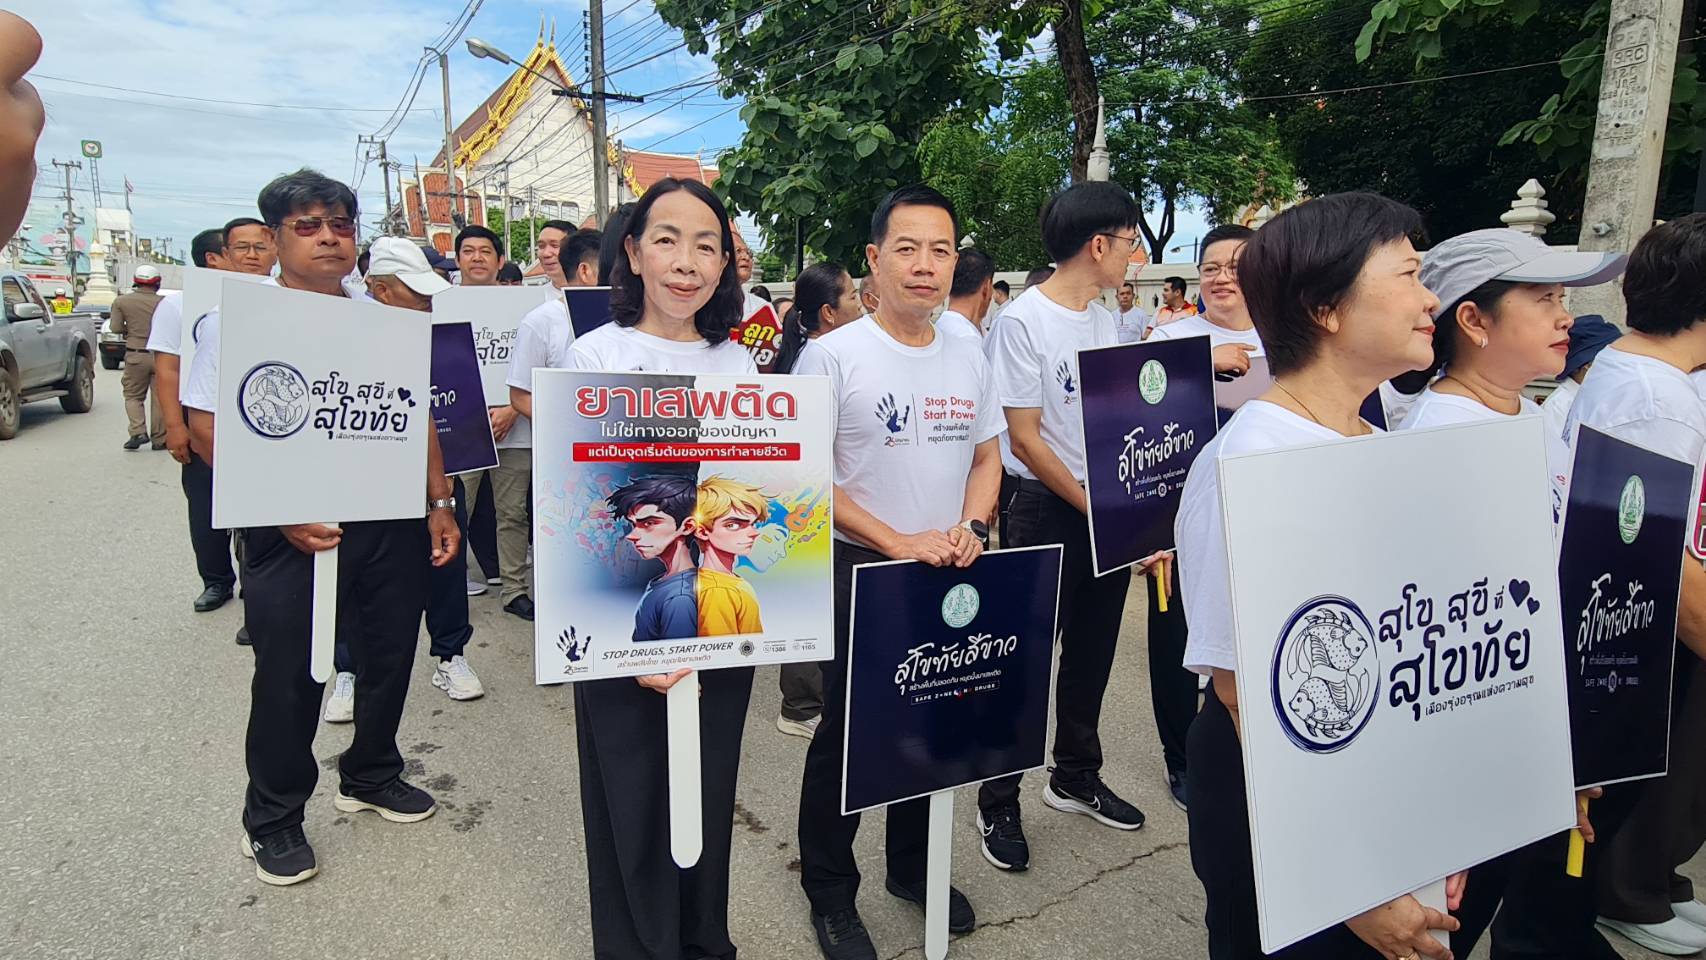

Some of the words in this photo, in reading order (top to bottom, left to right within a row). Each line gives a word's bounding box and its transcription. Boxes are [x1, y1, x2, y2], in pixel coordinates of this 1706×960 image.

[742, 323, 775, 345] ลูก
[311, 372, 349, 403] สุโข
[357, 381, 385, 403] สุขี
[575, 383, 798, 420] ยาเสพติด
[924, 397, 947, 409] Stop
[313, 396, 408, 440] สุโขทัย
[599, 421, 777, 440] ไม่ใช่ทางออกของปัญหา
[923, 410, 946, 420] Start
[588, 443, 787, 459] แต่เป็นจุดเริ่มต้นของการทำลายชีวิต
[1118, 422, 1194, 495] สุโขทัยสีขาว
[1379, 583, 1433, 652] สุโข
[1448, 577, 1489, 632] สุขี
[1494, 585, 1504, 610] ที่
[1577, 572, 1654, 676] สุโขทัยสีขาว
[602, 650, 629, 660] STOP
[630, 647, 665, 658] DRUGS,
[668, 645, 698, 655] START
[699, 641, 734, 652] POWER
[895, 633, 1017, 695] สุโขทัยสีขาว
[1389, 619, 1531, 722] สุโขทัย
[1425, 674, 1535, 717] เมืองรุ่งอรุณแห่งความสุข
